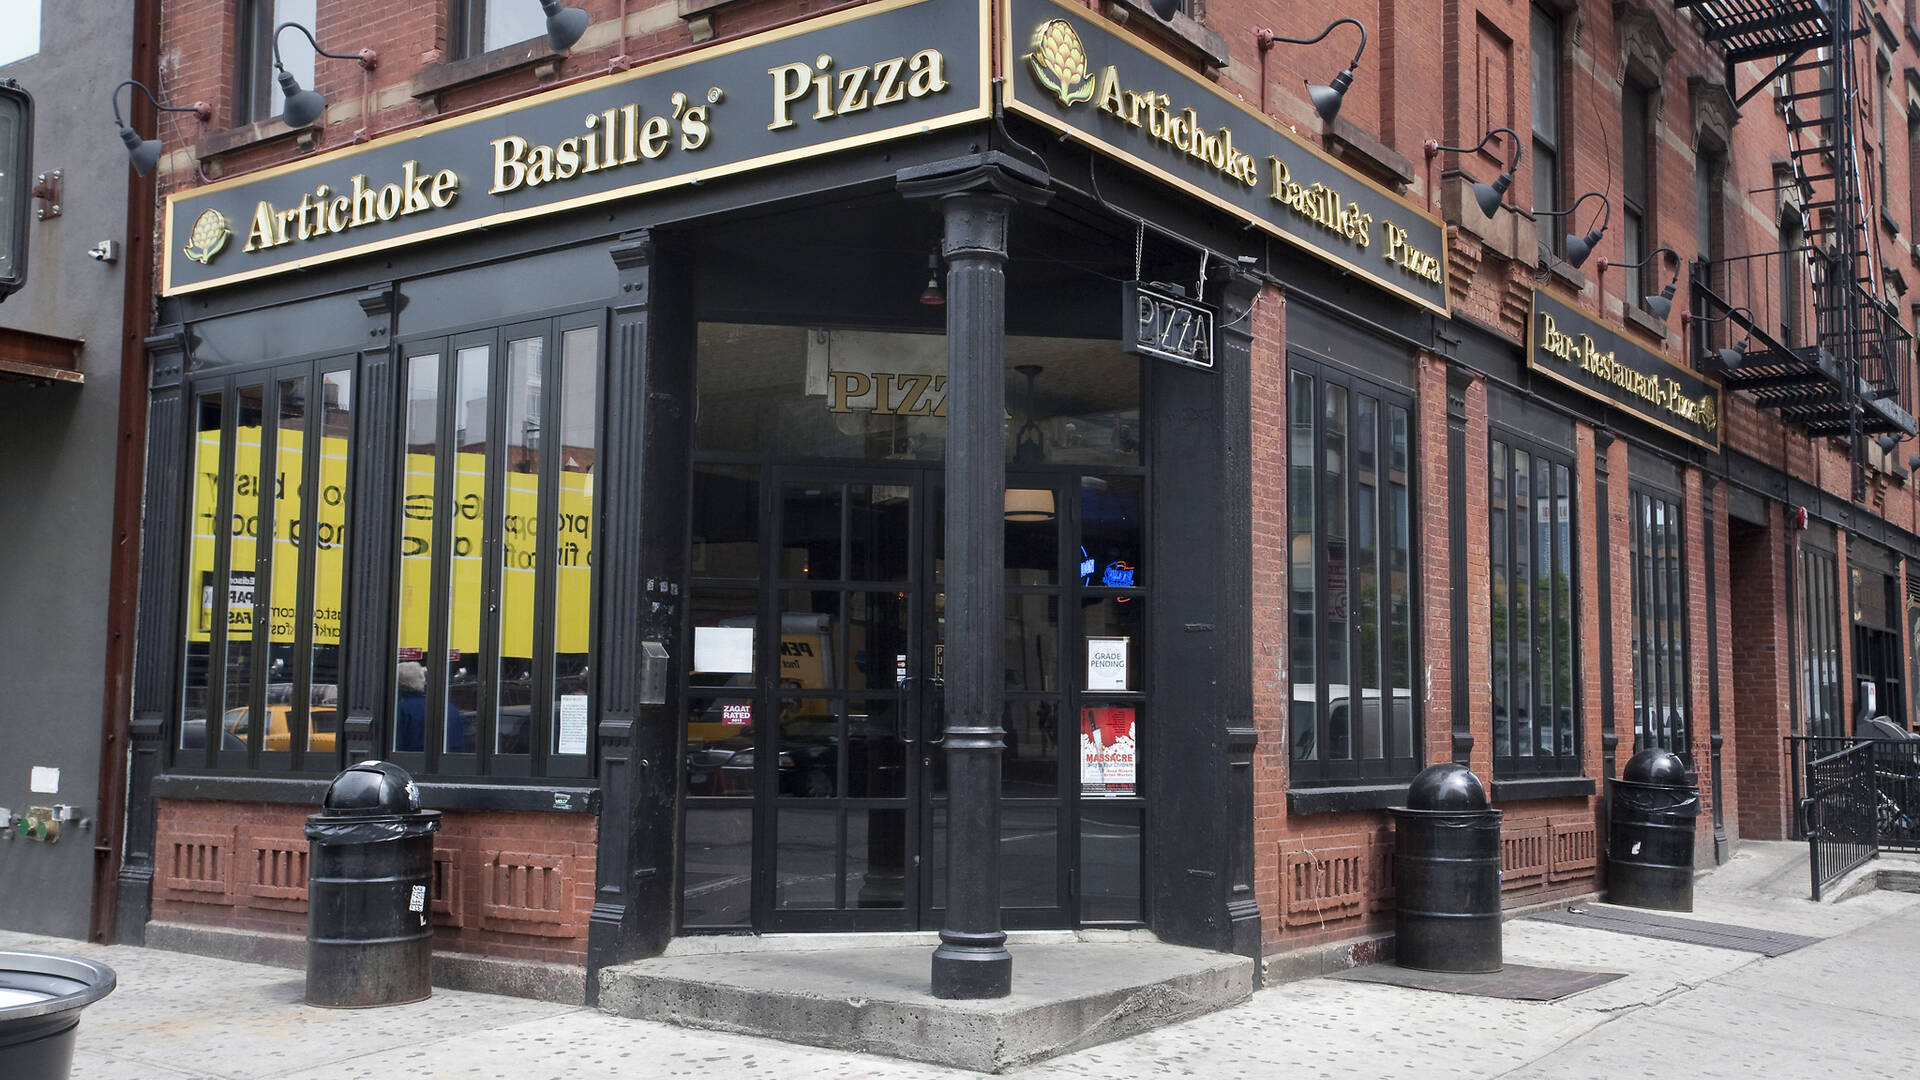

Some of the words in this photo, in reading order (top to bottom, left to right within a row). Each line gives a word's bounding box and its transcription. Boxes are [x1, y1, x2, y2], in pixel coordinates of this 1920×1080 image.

[242, 159, 460, 252] Artichoke
[488, 91, 711, 195] Basille's
[768, 48, 951, 131] Pizza
[1097, 65, 1258, 187] Artichoke
[1266, 155, 1370, 247] Basille's
[1383, 220, 1443, 285] Pizza
[1137, 295, 1209, 361] PIZZA
[829, 371, 1013, 419] PIZ
[1090, 660, 1125, 668] PENDING
[1094, 652, 1122, 660] GRADE
[1086, 753, 1133, 763] MASSACRE
